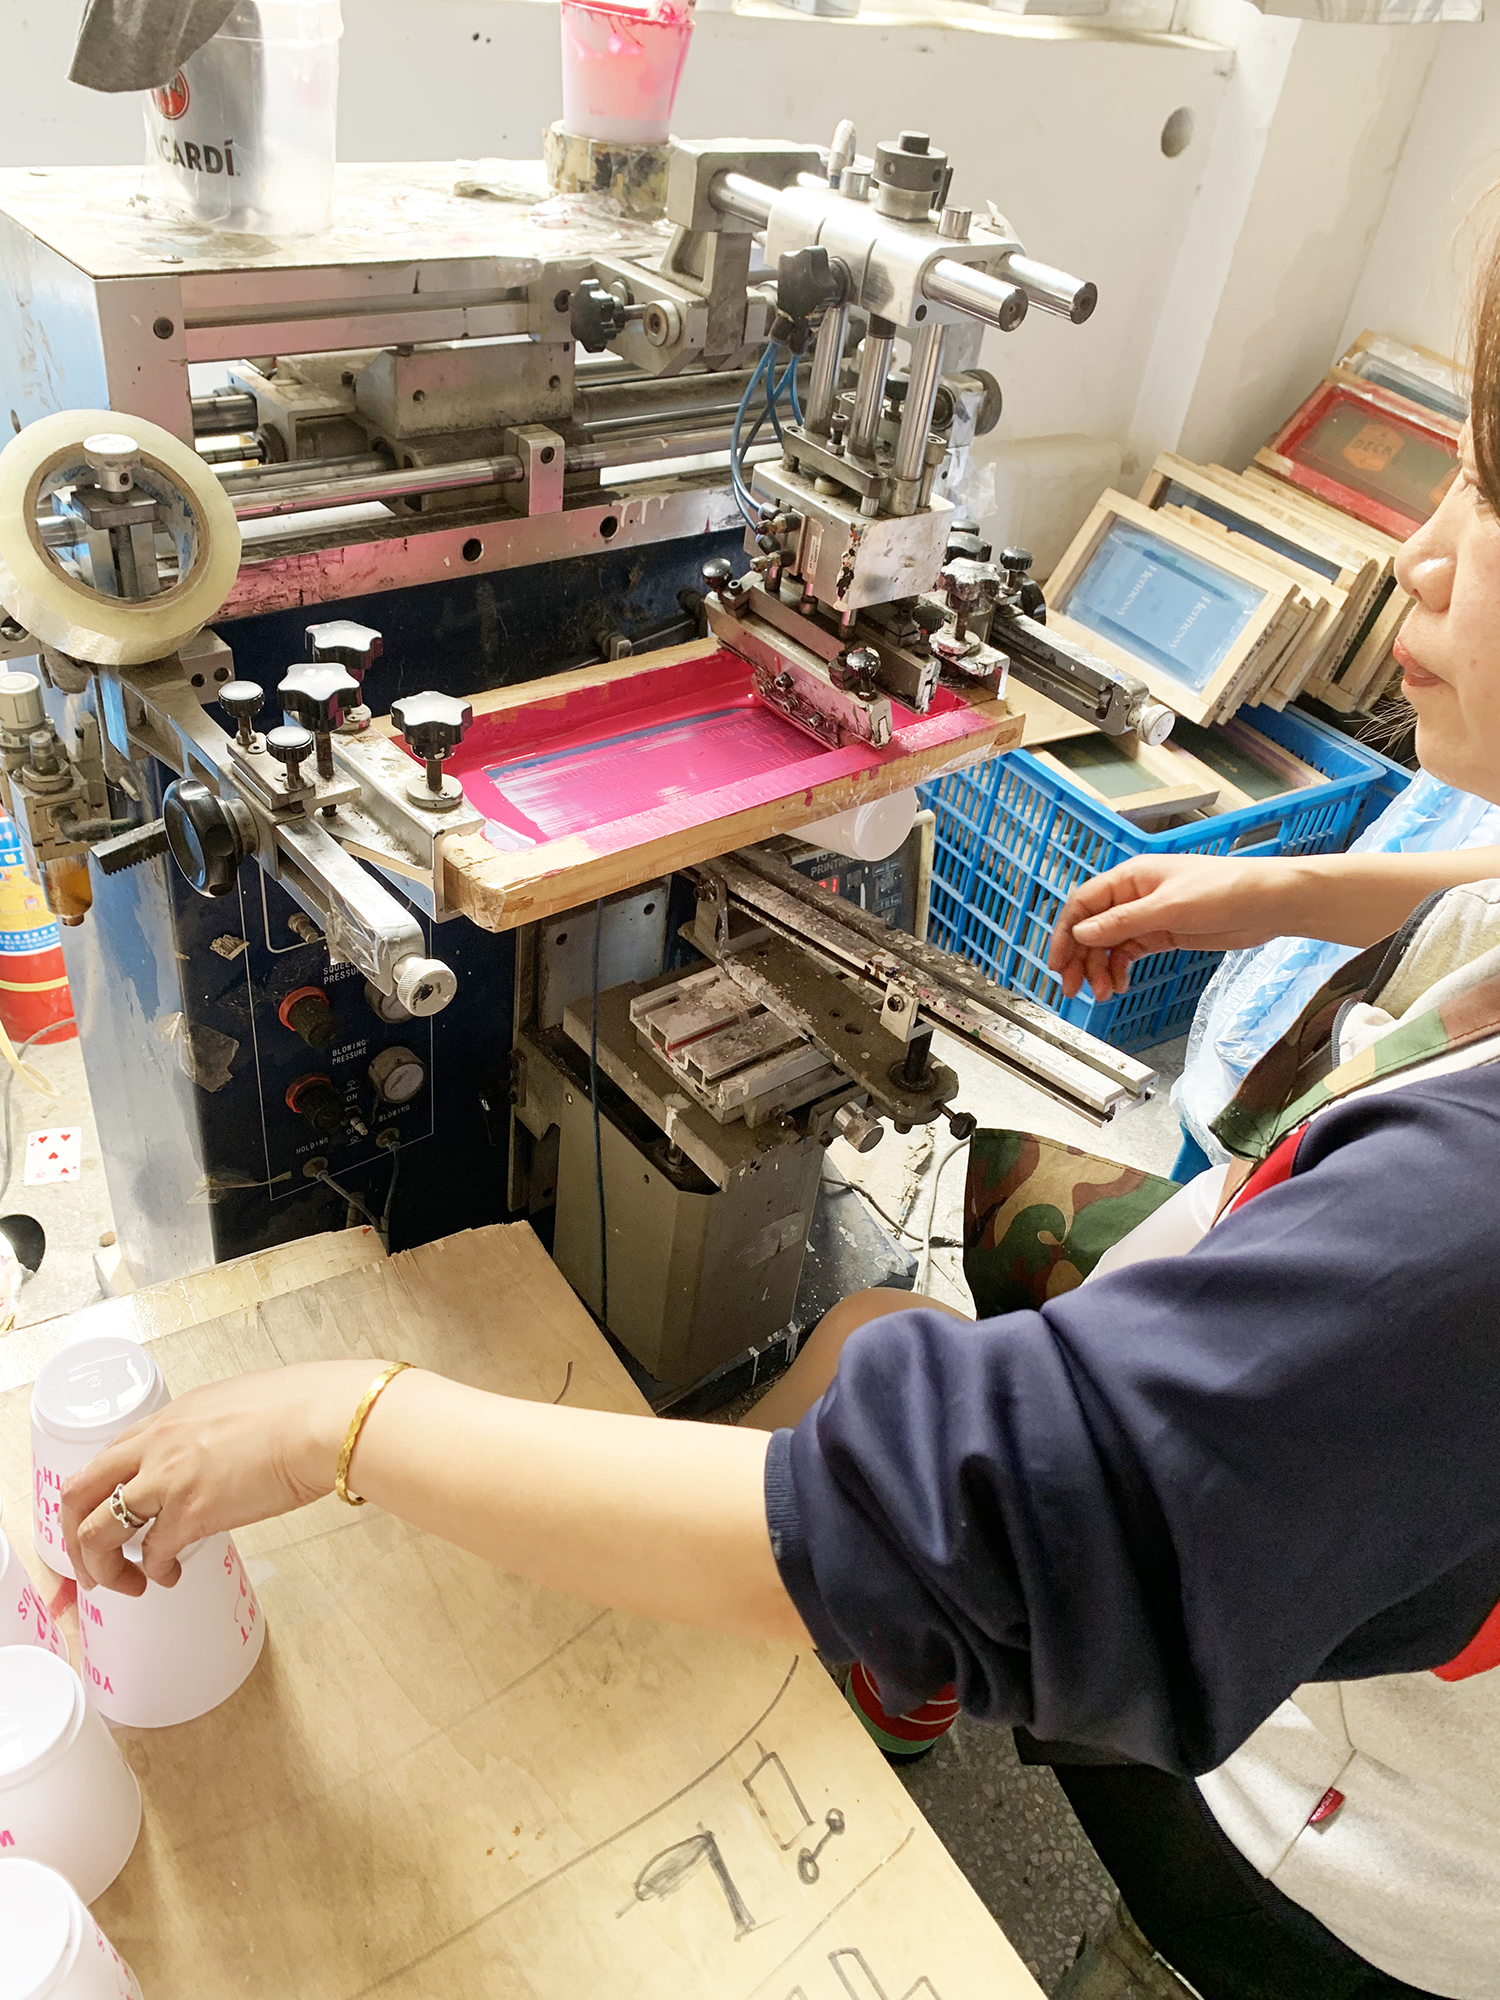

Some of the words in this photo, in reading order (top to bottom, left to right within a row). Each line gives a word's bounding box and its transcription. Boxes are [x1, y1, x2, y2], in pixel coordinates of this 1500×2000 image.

[158, 137, 236, 176] CARDÍ
[1115, 564, 1157, 615] Hennessy
[1167, 596, 1211, 648] Hennessy
[323, 961, 355, 976] SQUEE
[331, 1046, 367, 1065] PRESSURE
[332, 1039, 366, 1057] BLOWING
[346, 1093, 358, 1102] ON
[378, 1104, 411, 1122] BLOWING
[296, 1137, 329, 1155] HOLDING
[43, 1466, 61, 1491] TH
[17, 1587, 32, 1621] US
[80, 1592, 104, 1628] WIT
[84, 1655, 115, 1695] YOU
